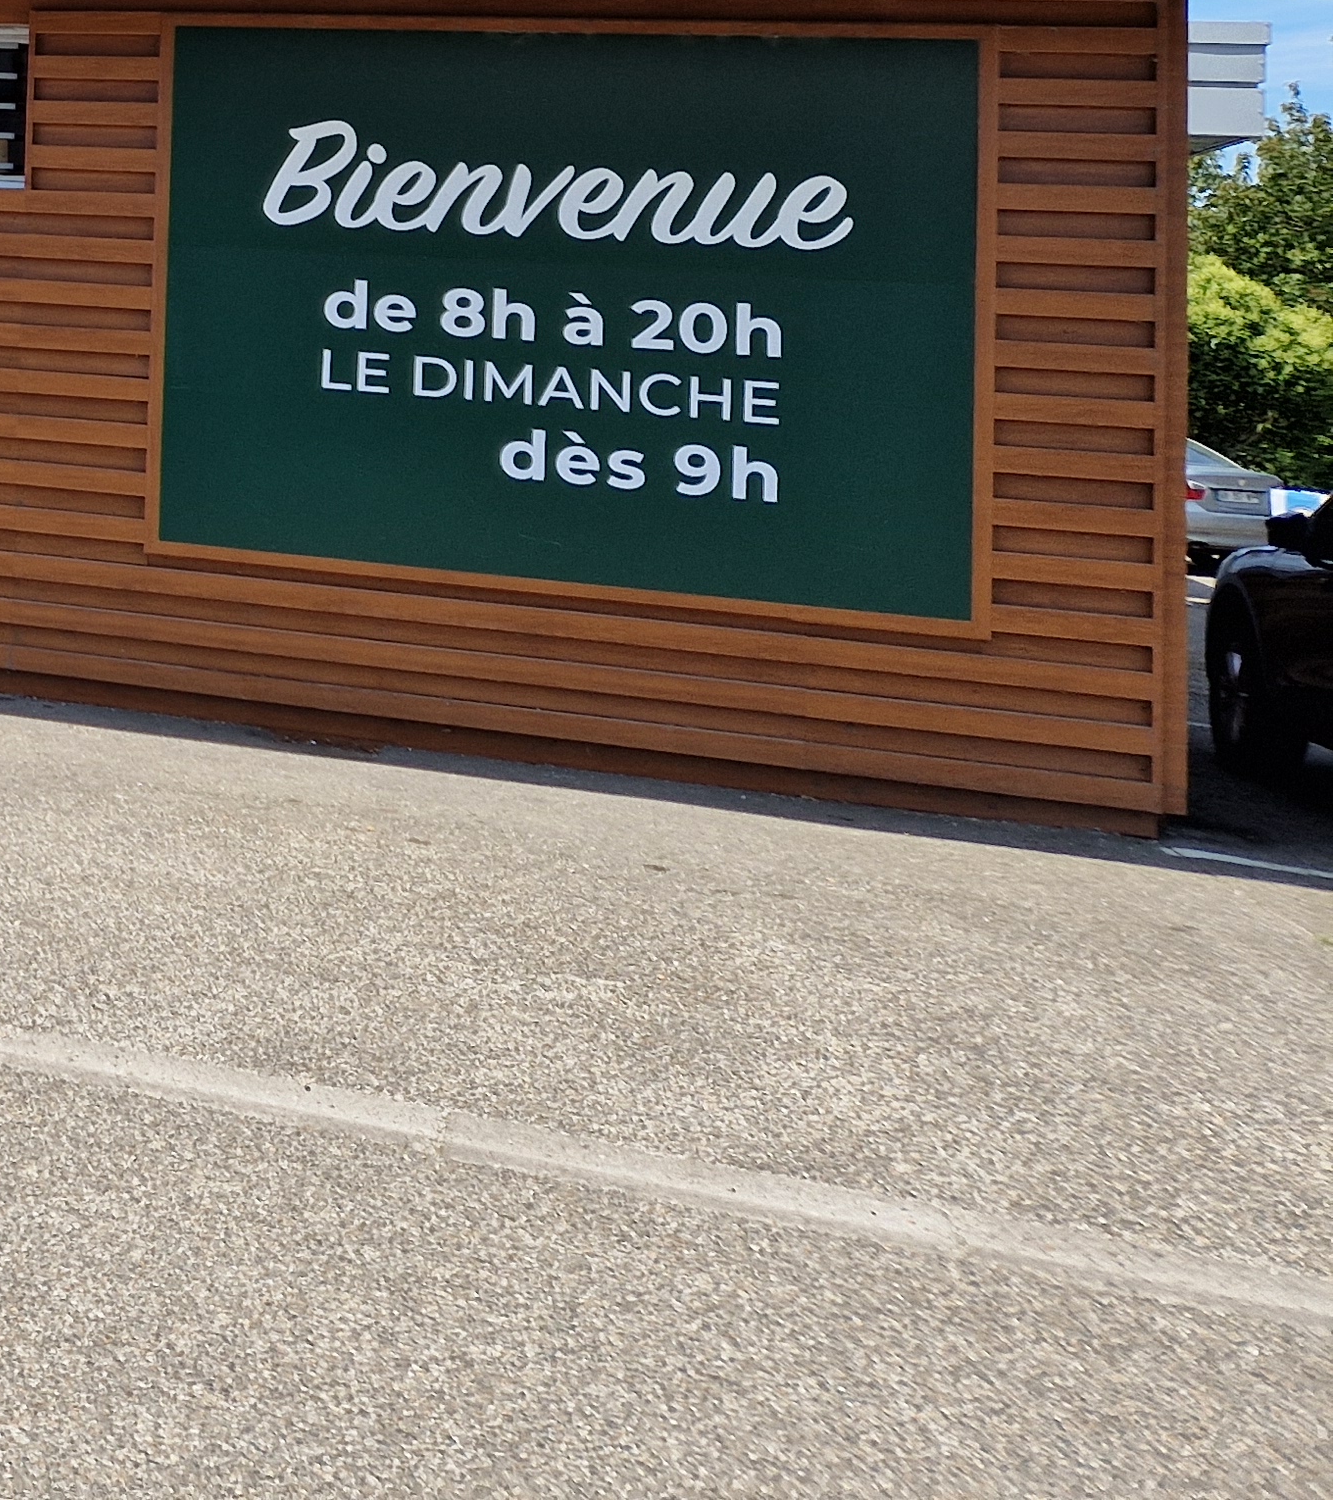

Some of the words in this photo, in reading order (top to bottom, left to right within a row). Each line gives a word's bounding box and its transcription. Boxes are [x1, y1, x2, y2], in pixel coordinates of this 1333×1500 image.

[261, 119, 855, 250] Bienvenue
[323, 279, 417, 333] de
[439, 287, 536, 343] 8h
[562, 292, 605, 347] à
[629, 298, 783, 358] 20h
[319, 348, 391, 395] LE
[412, 355, 781, 427] DIMANCHE
[498, 428, 646, 491] dès
[673, 443, 780, 503] 9h
